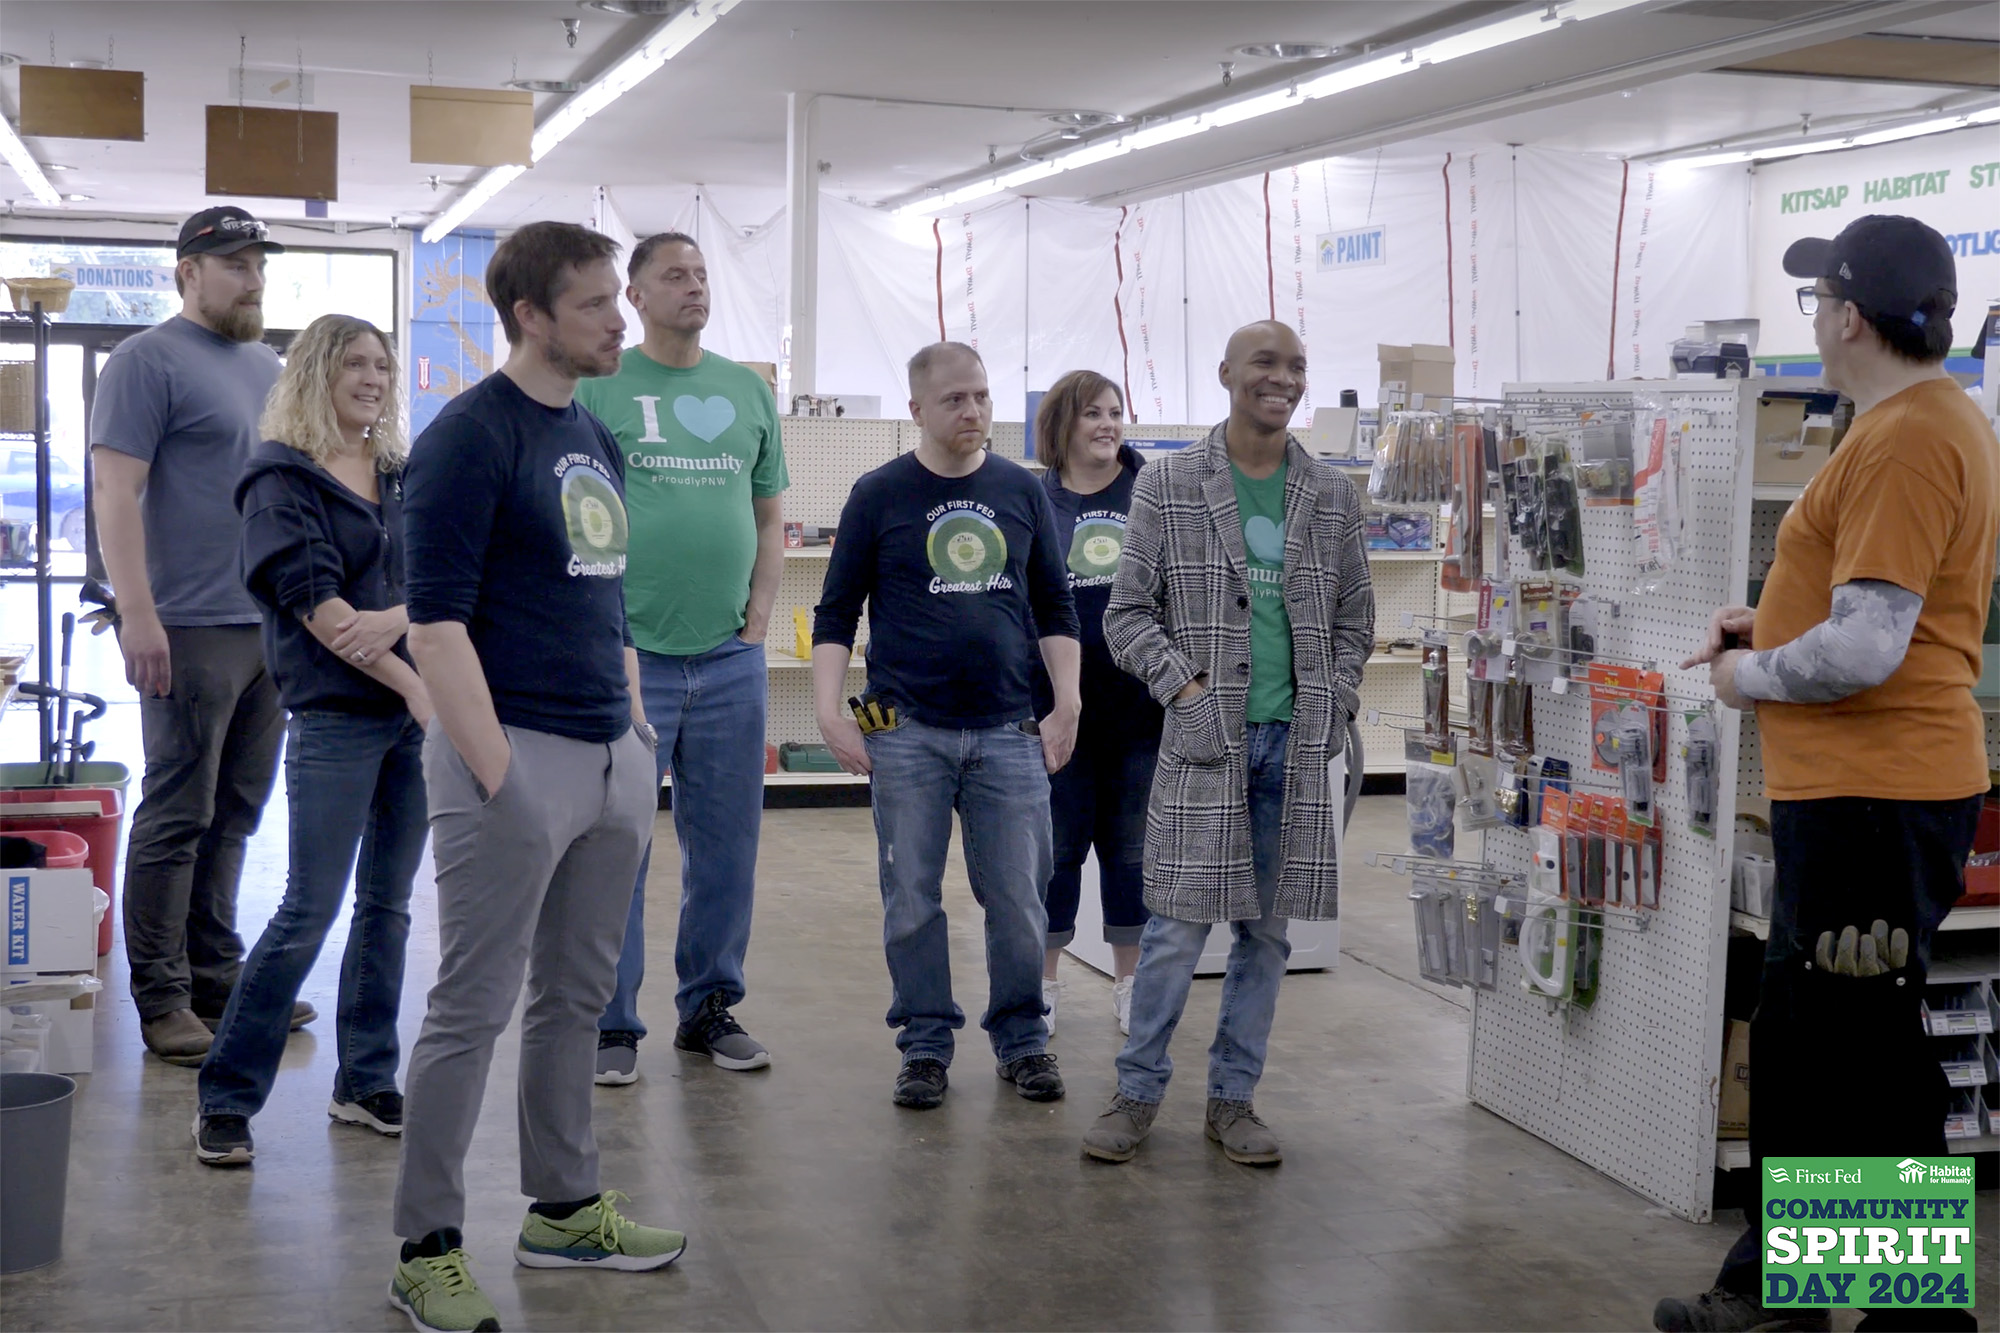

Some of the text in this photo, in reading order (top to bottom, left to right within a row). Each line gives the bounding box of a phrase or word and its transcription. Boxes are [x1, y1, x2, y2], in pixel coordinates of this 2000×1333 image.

[1781, 162, 2000, 214] KITSAP HABITAT ST
[1337, 231, 1382, 263] PAINT
[77, 268, 154, 287] DONATIONS
[633, 395, 667, 443] I
[554, 456, 569, 478] OUR
[568, 453, 591, 466] FIRST
[628, 452, 744, 474] Community
[652, 474, 727, 487] #ProudlyPNW
[926, 500, 996, 522] OUR FIRST FED
[1083, 510, 1109, 520] FIRST
[1110, 511, 1128, 522] FED
[566, 554, 617, 577] Greatest
[929, 572, 1013, 594] Greatest Hits
[1067, 572, 1117, 589] Greatest
[12, 882, 26, 960] WATER KIT
